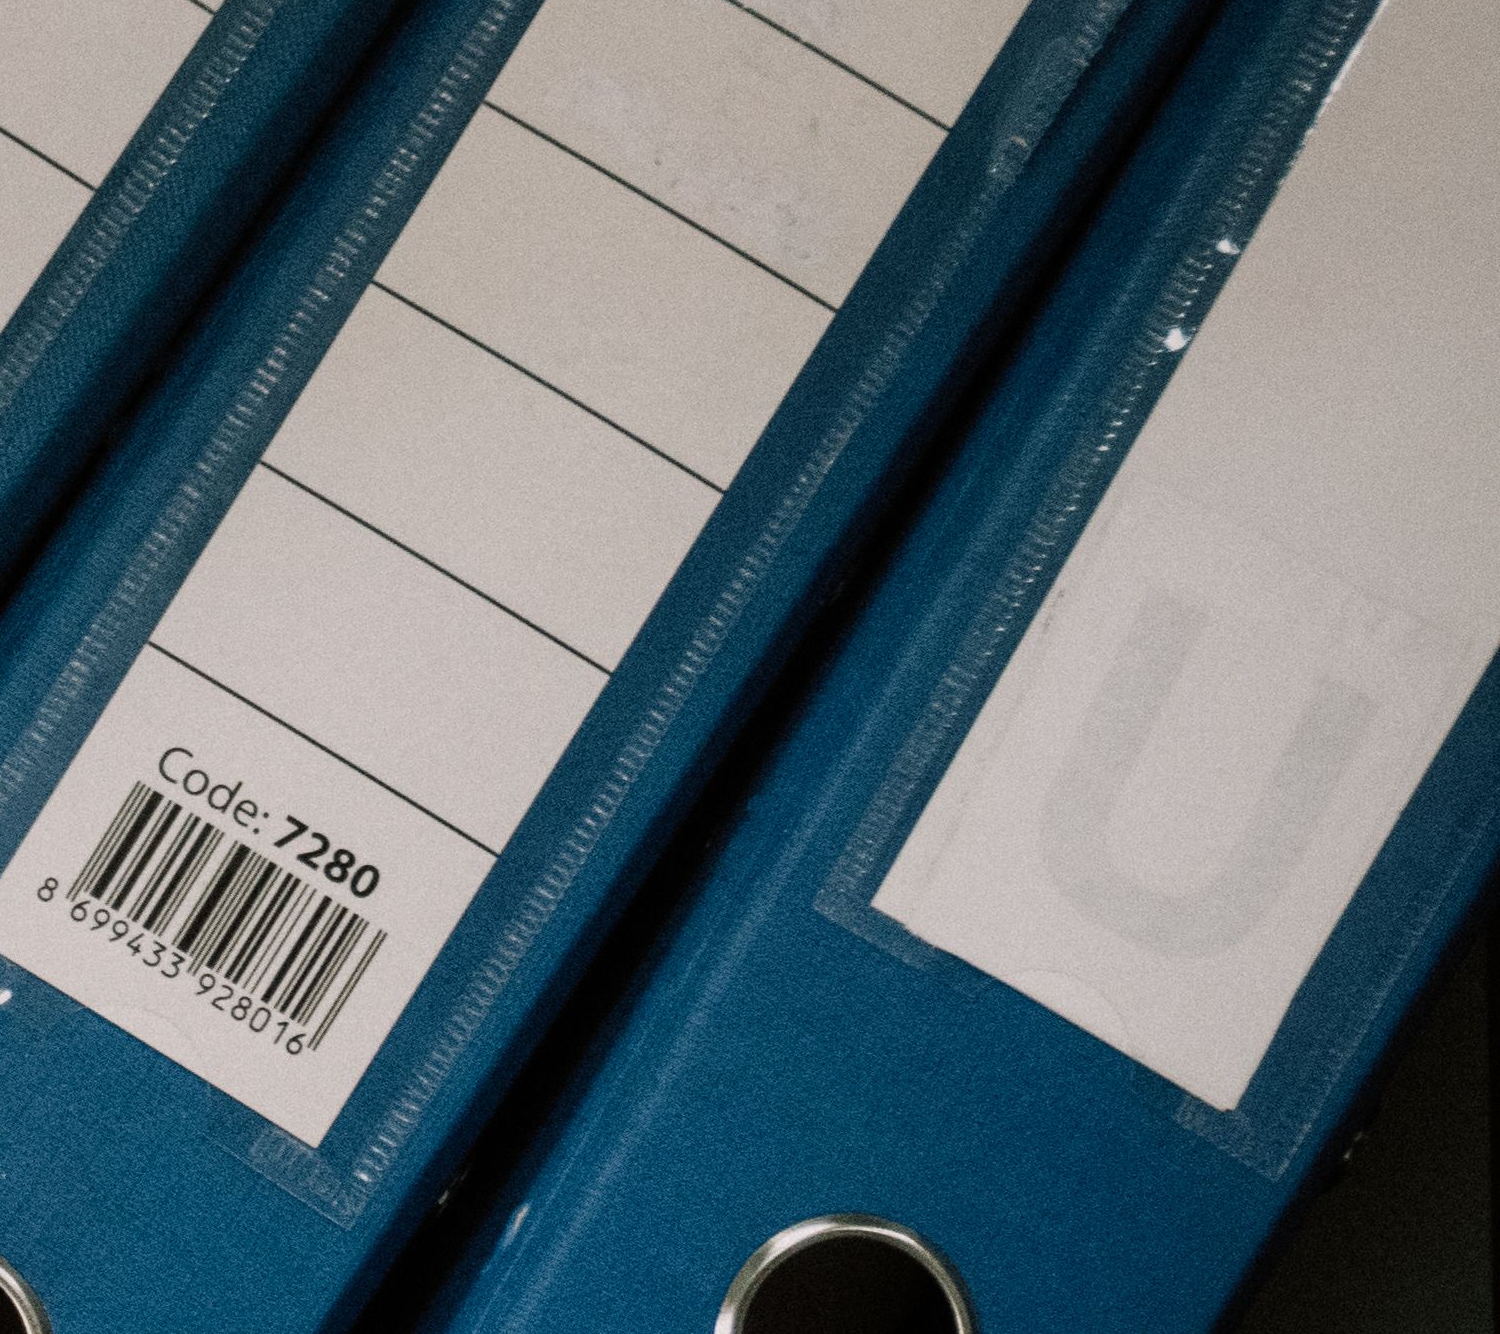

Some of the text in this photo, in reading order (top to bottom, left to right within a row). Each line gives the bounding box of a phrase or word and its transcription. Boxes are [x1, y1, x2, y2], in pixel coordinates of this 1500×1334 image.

[158, 746, 380, 898] Code: 7280
[37, 877, 307, 1056] 8 699433 928016
